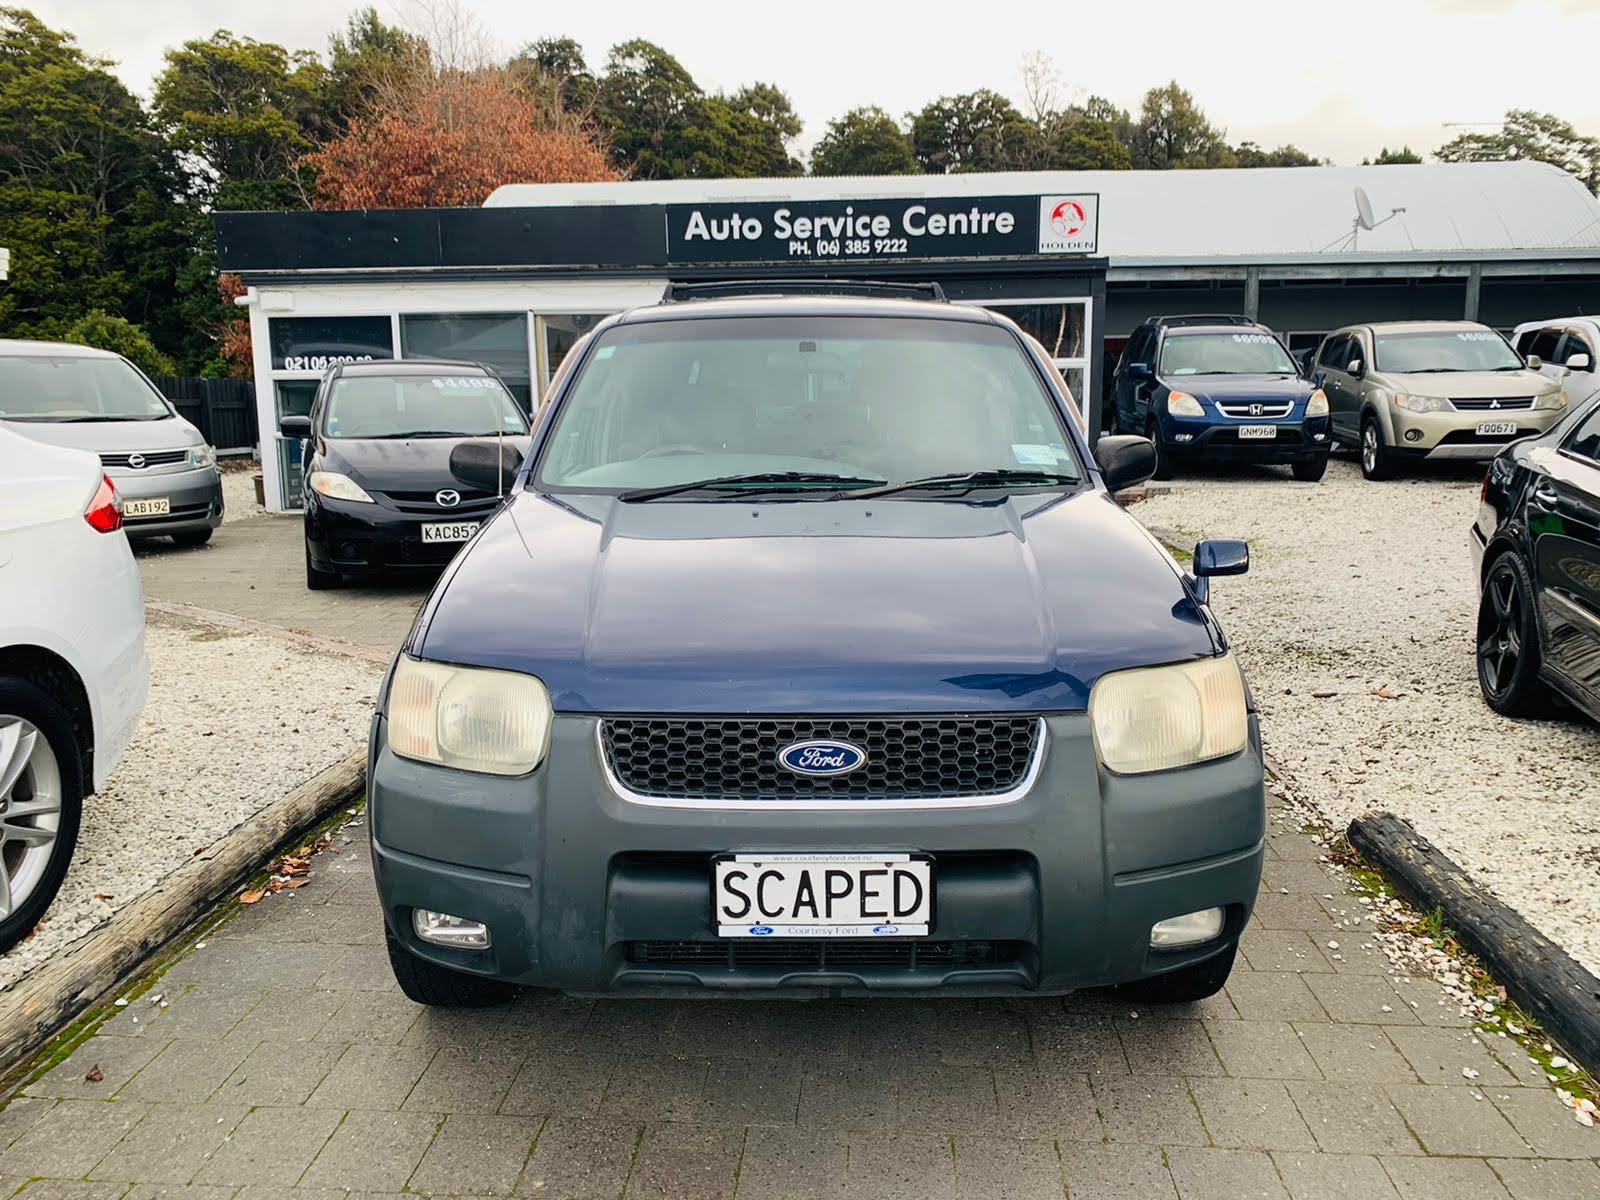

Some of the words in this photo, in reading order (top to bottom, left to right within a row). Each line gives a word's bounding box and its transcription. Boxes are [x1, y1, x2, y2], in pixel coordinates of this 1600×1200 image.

[684, 211, 763, 241] Auto
[773, 206, 891, 240] Service
[902, 205, 1015, 236] Centre
[788, 241, 812, 256] PH.
[816, 239, 840, 256] (06)
[845, 239, 870, 255] 385
[874, 238, 908, 254] 9222
[1041, 241, 1095, 250] HOLDEN
[125, 501, 168, 514] LAB192
[799, 747, 846, 767] Ford
[722, 869, 923, 918] SCAPED
[787, 926, 832, 936] Courtesy
[835, 926, 859, 935] Ford
